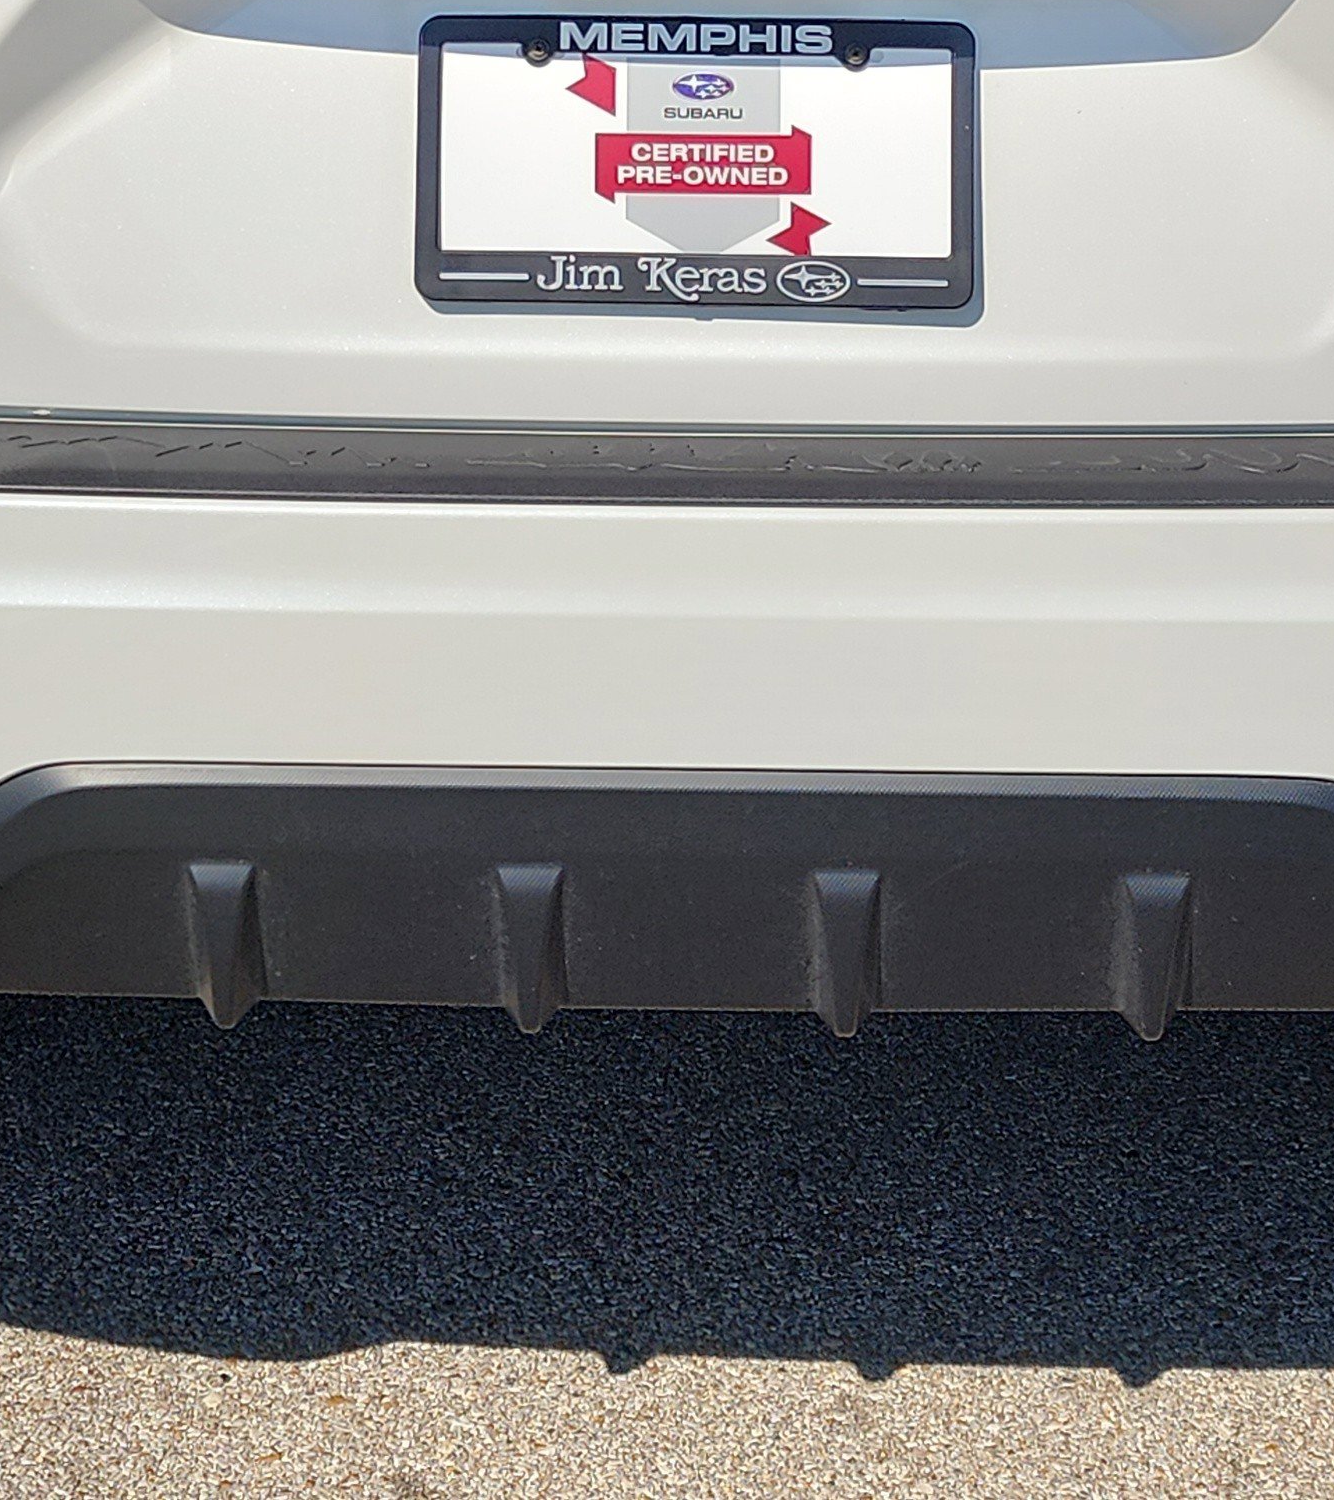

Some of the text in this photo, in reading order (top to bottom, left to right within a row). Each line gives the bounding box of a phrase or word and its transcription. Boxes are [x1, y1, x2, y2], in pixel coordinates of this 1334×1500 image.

[559, 21, 834, 55] MEMPHIS
[663, 106, 744, 120] SUBARU
[630, 142, 776, 164] CERTIFIED
[616, 165, 789, 187] PRE-OWNED
[536, 254, 768, 302] Jim Keras
